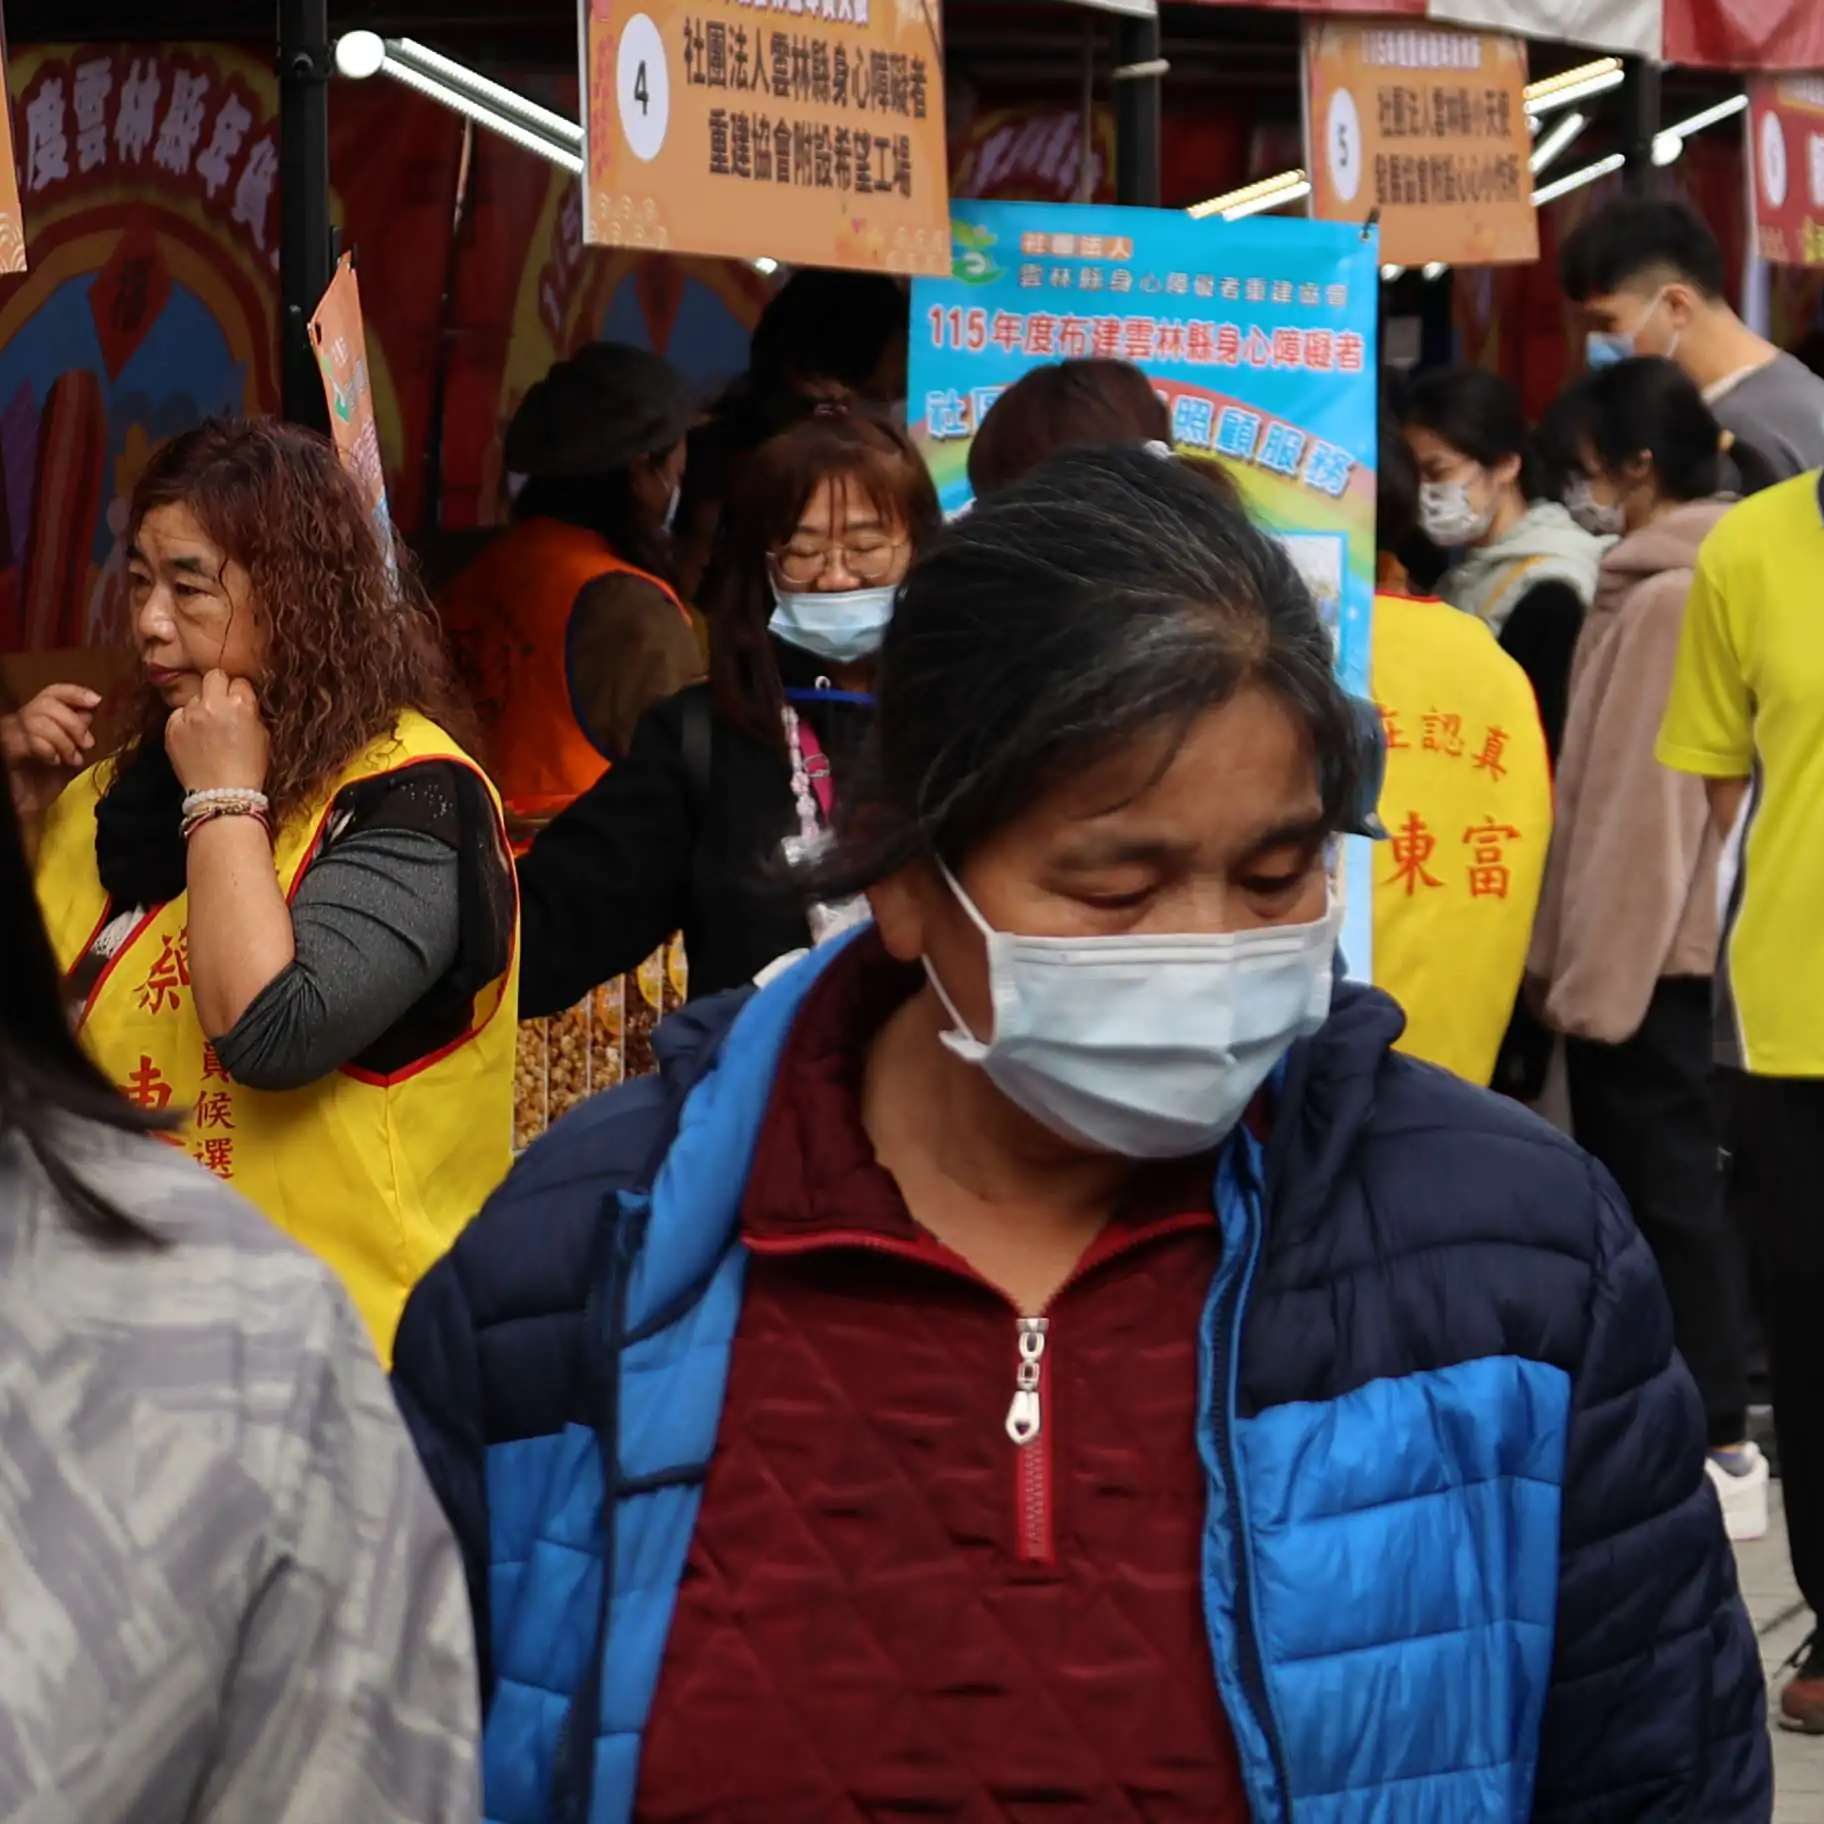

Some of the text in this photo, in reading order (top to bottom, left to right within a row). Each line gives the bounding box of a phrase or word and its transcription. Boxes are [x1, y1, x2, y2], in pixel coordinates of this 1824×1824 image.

[634, 59, 650, 116] 4
[683, 18, 927, 119] 社團法人雲林縣身心障礙者
[708, 108, 912, 199] 重建協會附設希望工場
[1021, 233, 1132, 260] 社團法人
[1019, 265, 1349, 307] 雲林縣身心障礙者重建協會
[929, 303, 1365, 372] 115年度布建雲林縣身心障礙者
[1380, 809, 1522, 899] 東富
